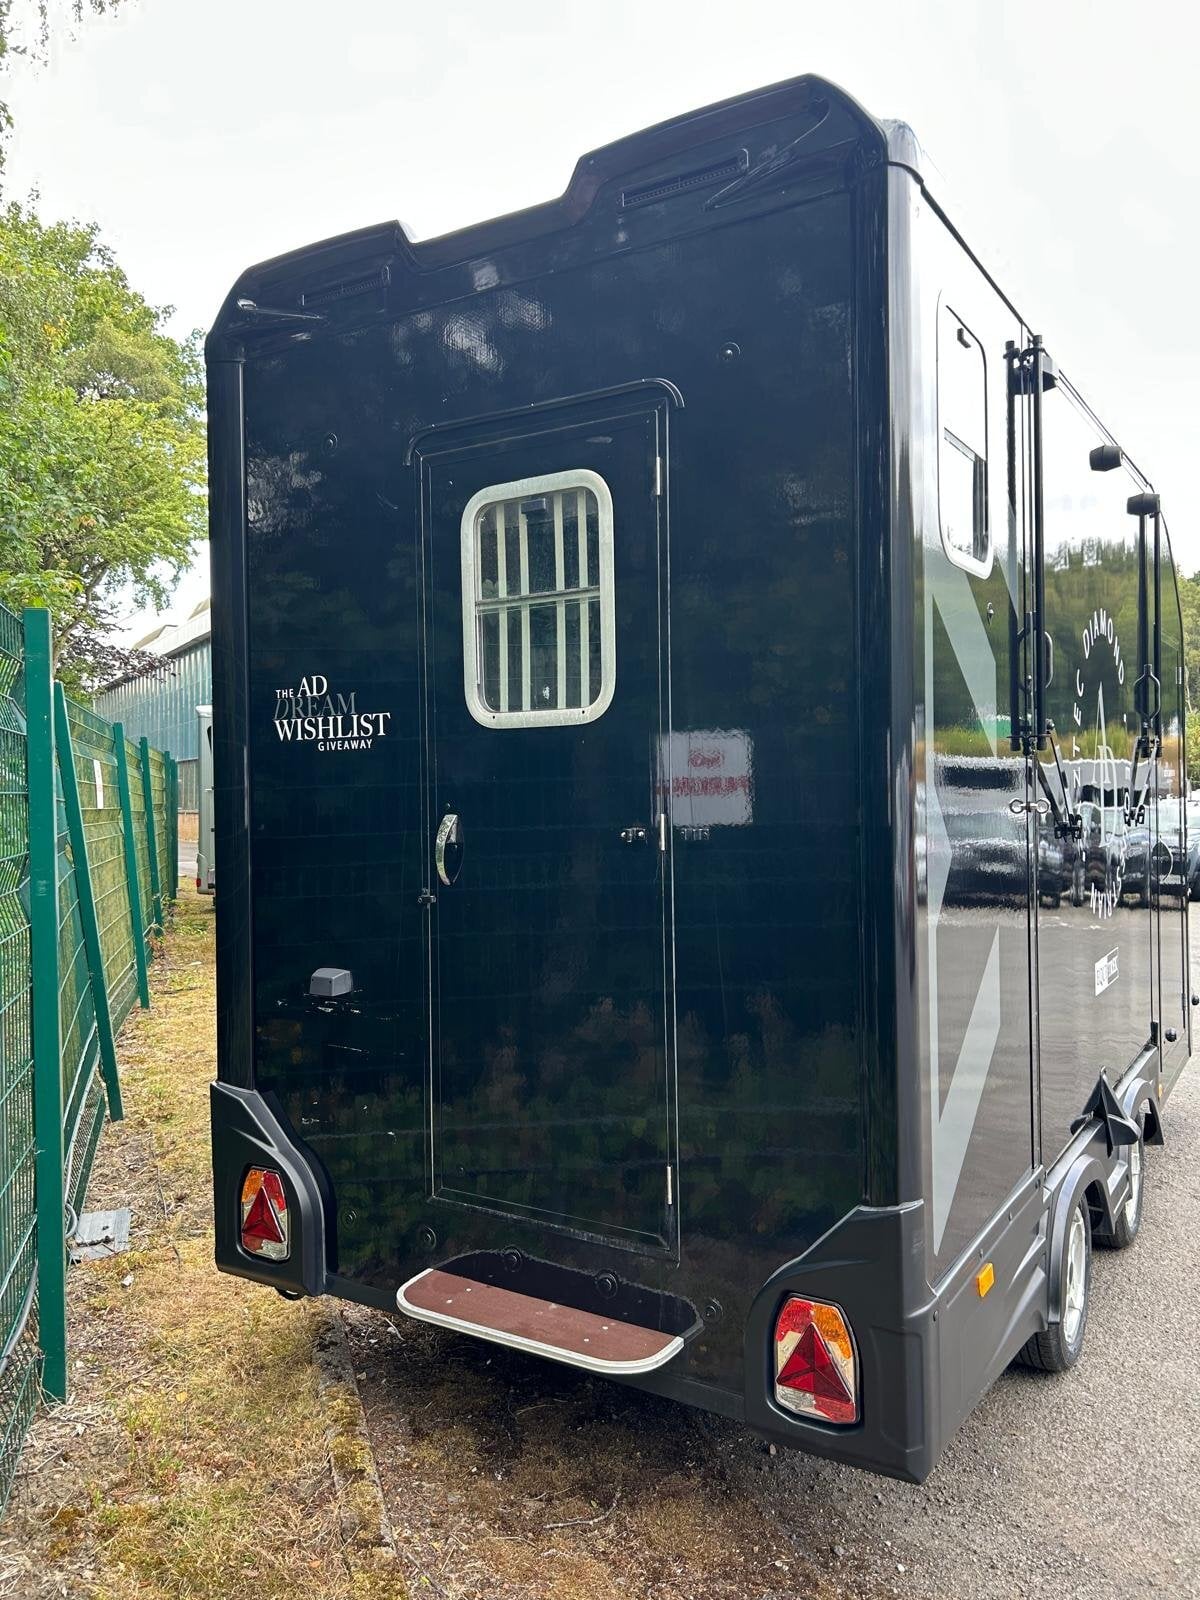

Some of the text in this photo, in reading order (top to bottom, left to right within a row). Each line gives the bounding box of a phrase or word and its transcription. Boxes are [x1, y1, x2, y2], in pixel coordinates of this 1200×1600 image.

[1082, 607, 1125, 686] DIAMOND
[276, 675, 328, 699] THE AD
[273, 691, 357, 720] DREAM
[274, 712, 391, 742] WISHLIST
[317, 738, 374, 752] GIVEAWAY
